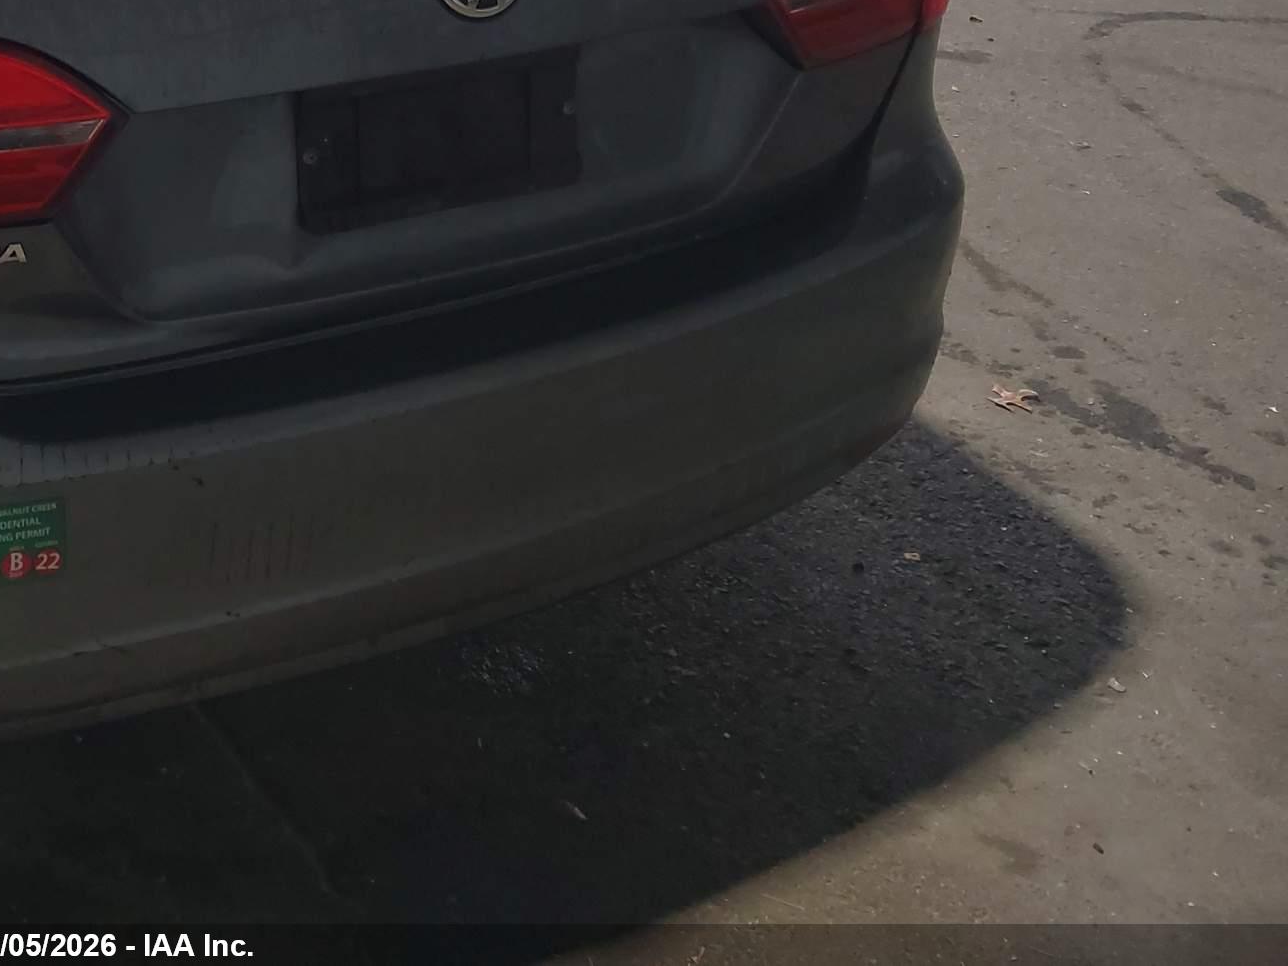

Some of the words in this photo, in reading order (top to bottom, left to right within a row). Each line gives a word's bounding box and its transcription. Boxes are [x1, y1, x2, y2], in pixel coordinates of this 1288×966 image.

[31, 501, 57, 513] CREEK
[15, 526, 51, 541] PERMIT
[10, 552, 24, 571] B
[35, 552, 61, 570] 22
